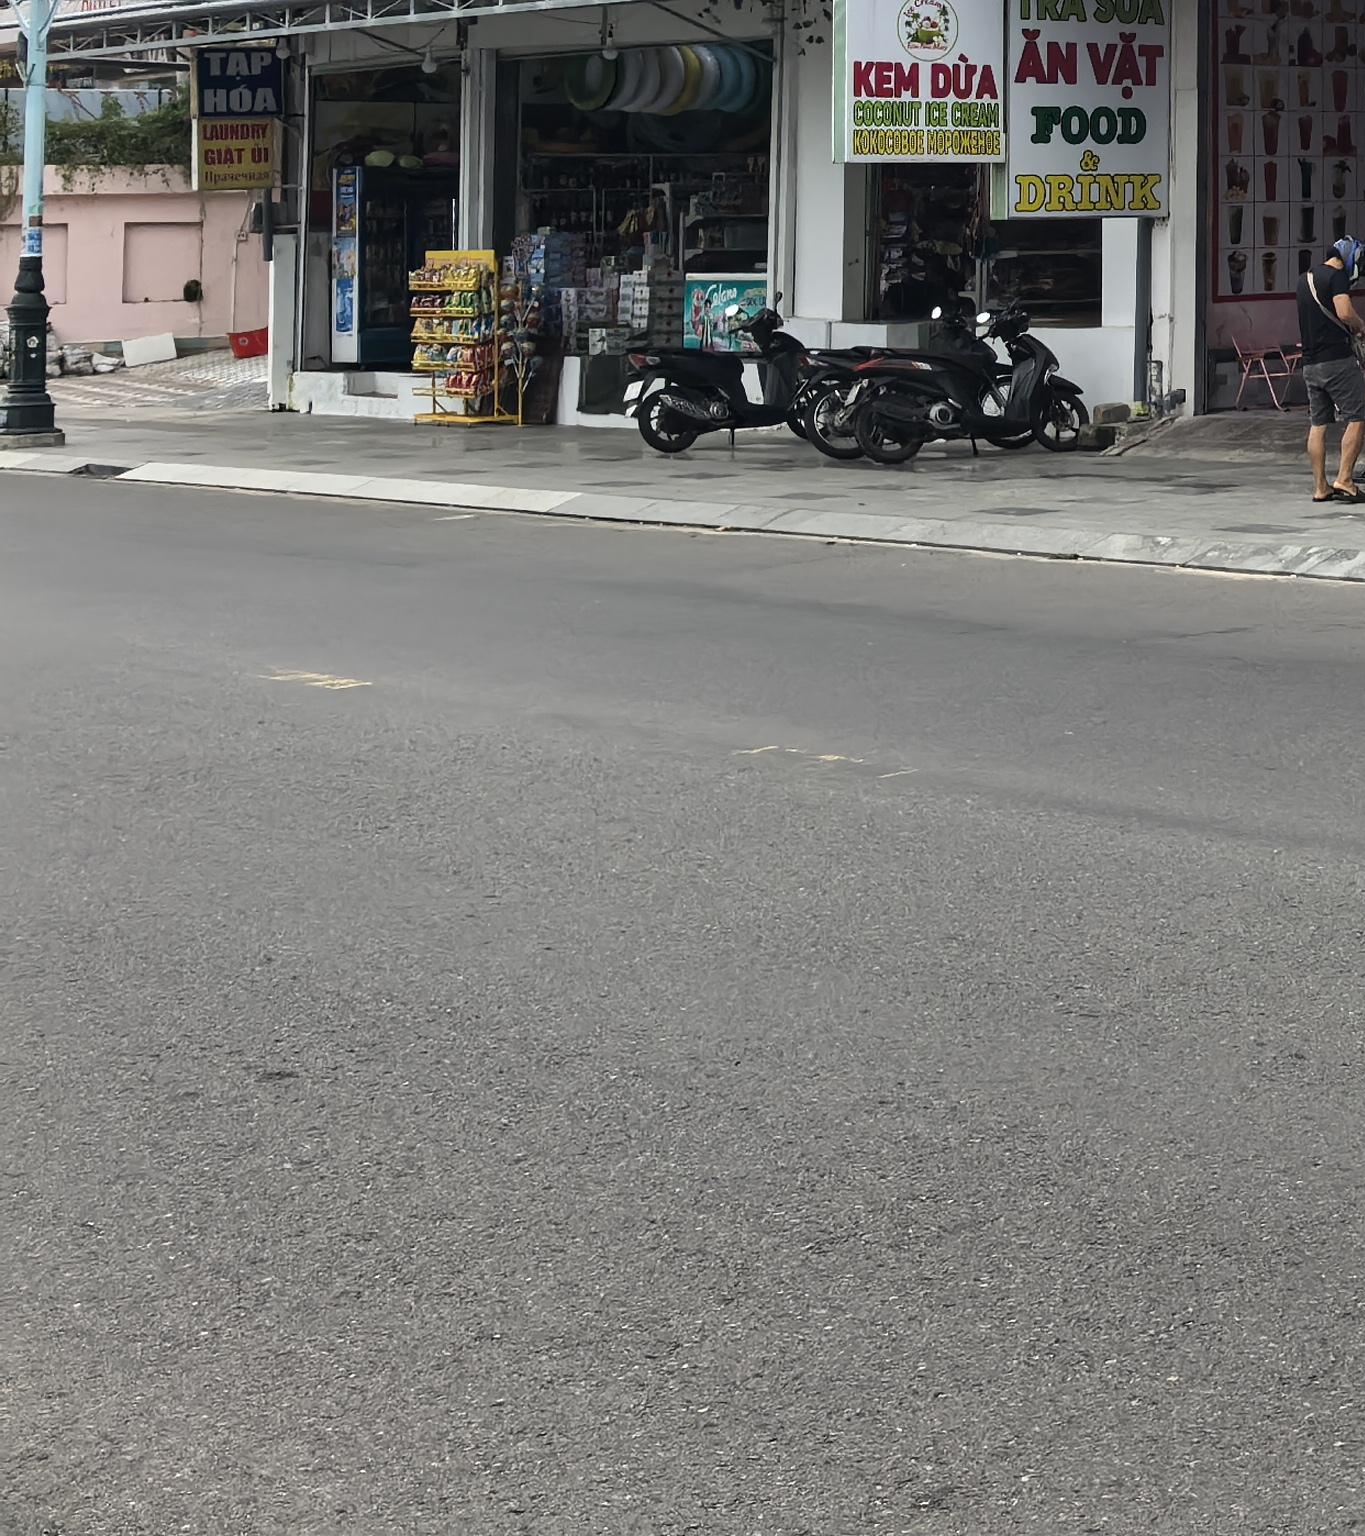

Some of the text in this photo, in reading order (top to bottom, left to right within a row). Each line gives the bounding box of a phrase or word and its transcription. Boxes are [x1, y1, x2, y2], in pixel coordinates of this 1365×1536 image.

[204, 52, 272, 80] TẠP
[853, 53, 998, 100] KEM DỪA
[1014, 28, 1164, 100] ĂN VẶT
[204, 84, 276, 112] HÓA
[853, 100, 1000, 128] COCONUT ICE CREAM
[1031, 106, 1146, 144] FOOD
[202, 124, 268, 141] LAUNDRY
[853, 130, 1000, 155] КОКОСОВОЕ МОРОЖЕНОЕ
[1080, 150, 1100, 172] &
[1015, 173, 1161, 212] DRINK
